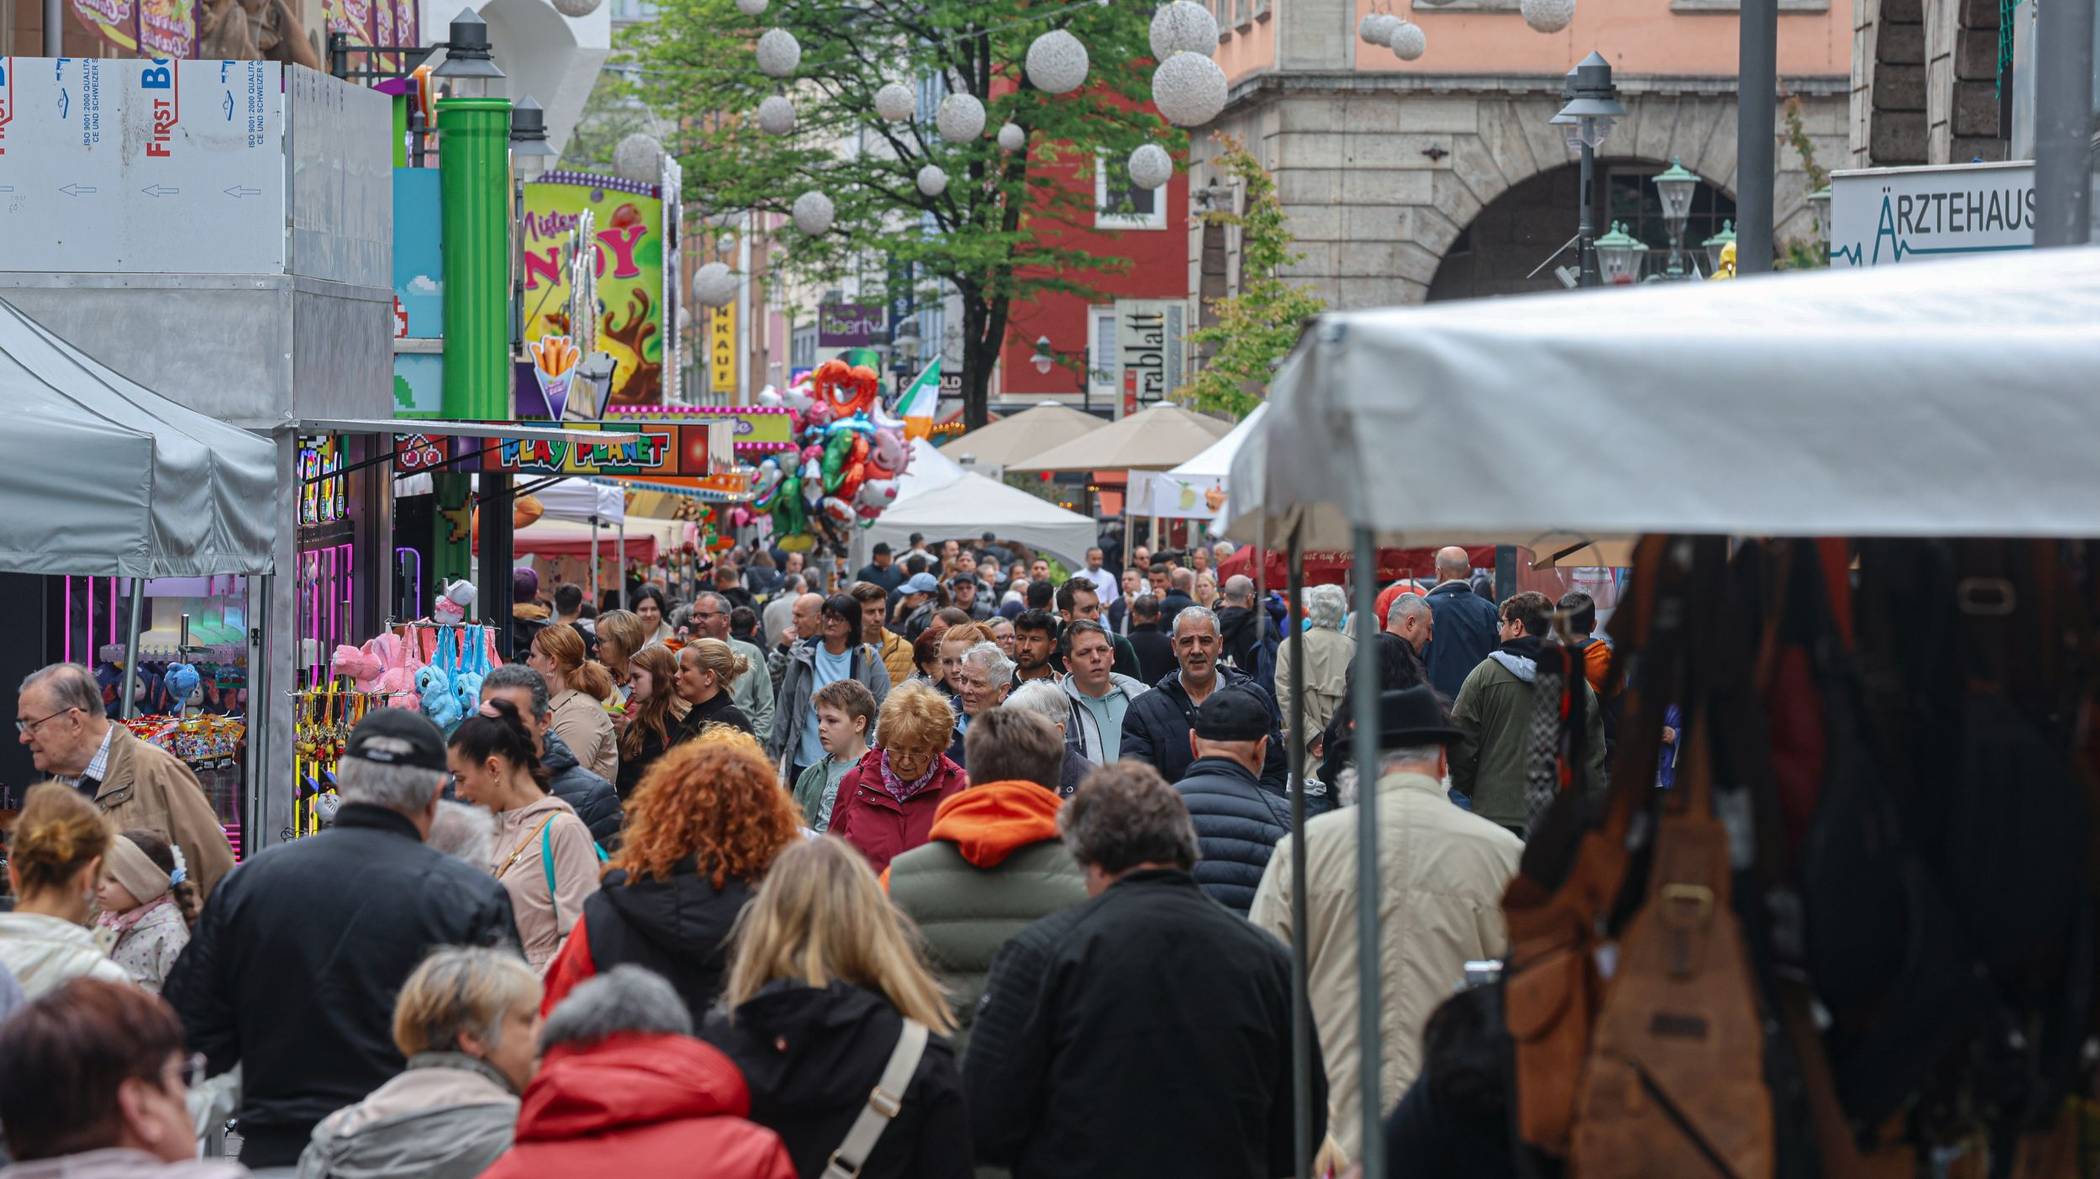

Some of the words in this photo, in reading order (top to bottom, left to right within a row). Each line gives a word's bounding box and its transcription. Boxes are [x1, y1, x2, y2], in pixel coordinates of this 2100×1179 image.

[141, 58, 171, 89] B
[256, 67, 264, 114] SCHWEIZER
[83, 93, 91, 131] 9001:2000
[248, 95, 256, 133] 9001:2000
[83, 131, 91, 146] ISO
[92, 131, 99, 143] CE
[248, 134, 256, 149] ISO
[257, 132, 264, 145] CE
[1874, 187, 2035, 248] ÄRZTEHAUS
[501, 437, 569, 469] PLAY
[575, 433, 669, 465] PLANET
